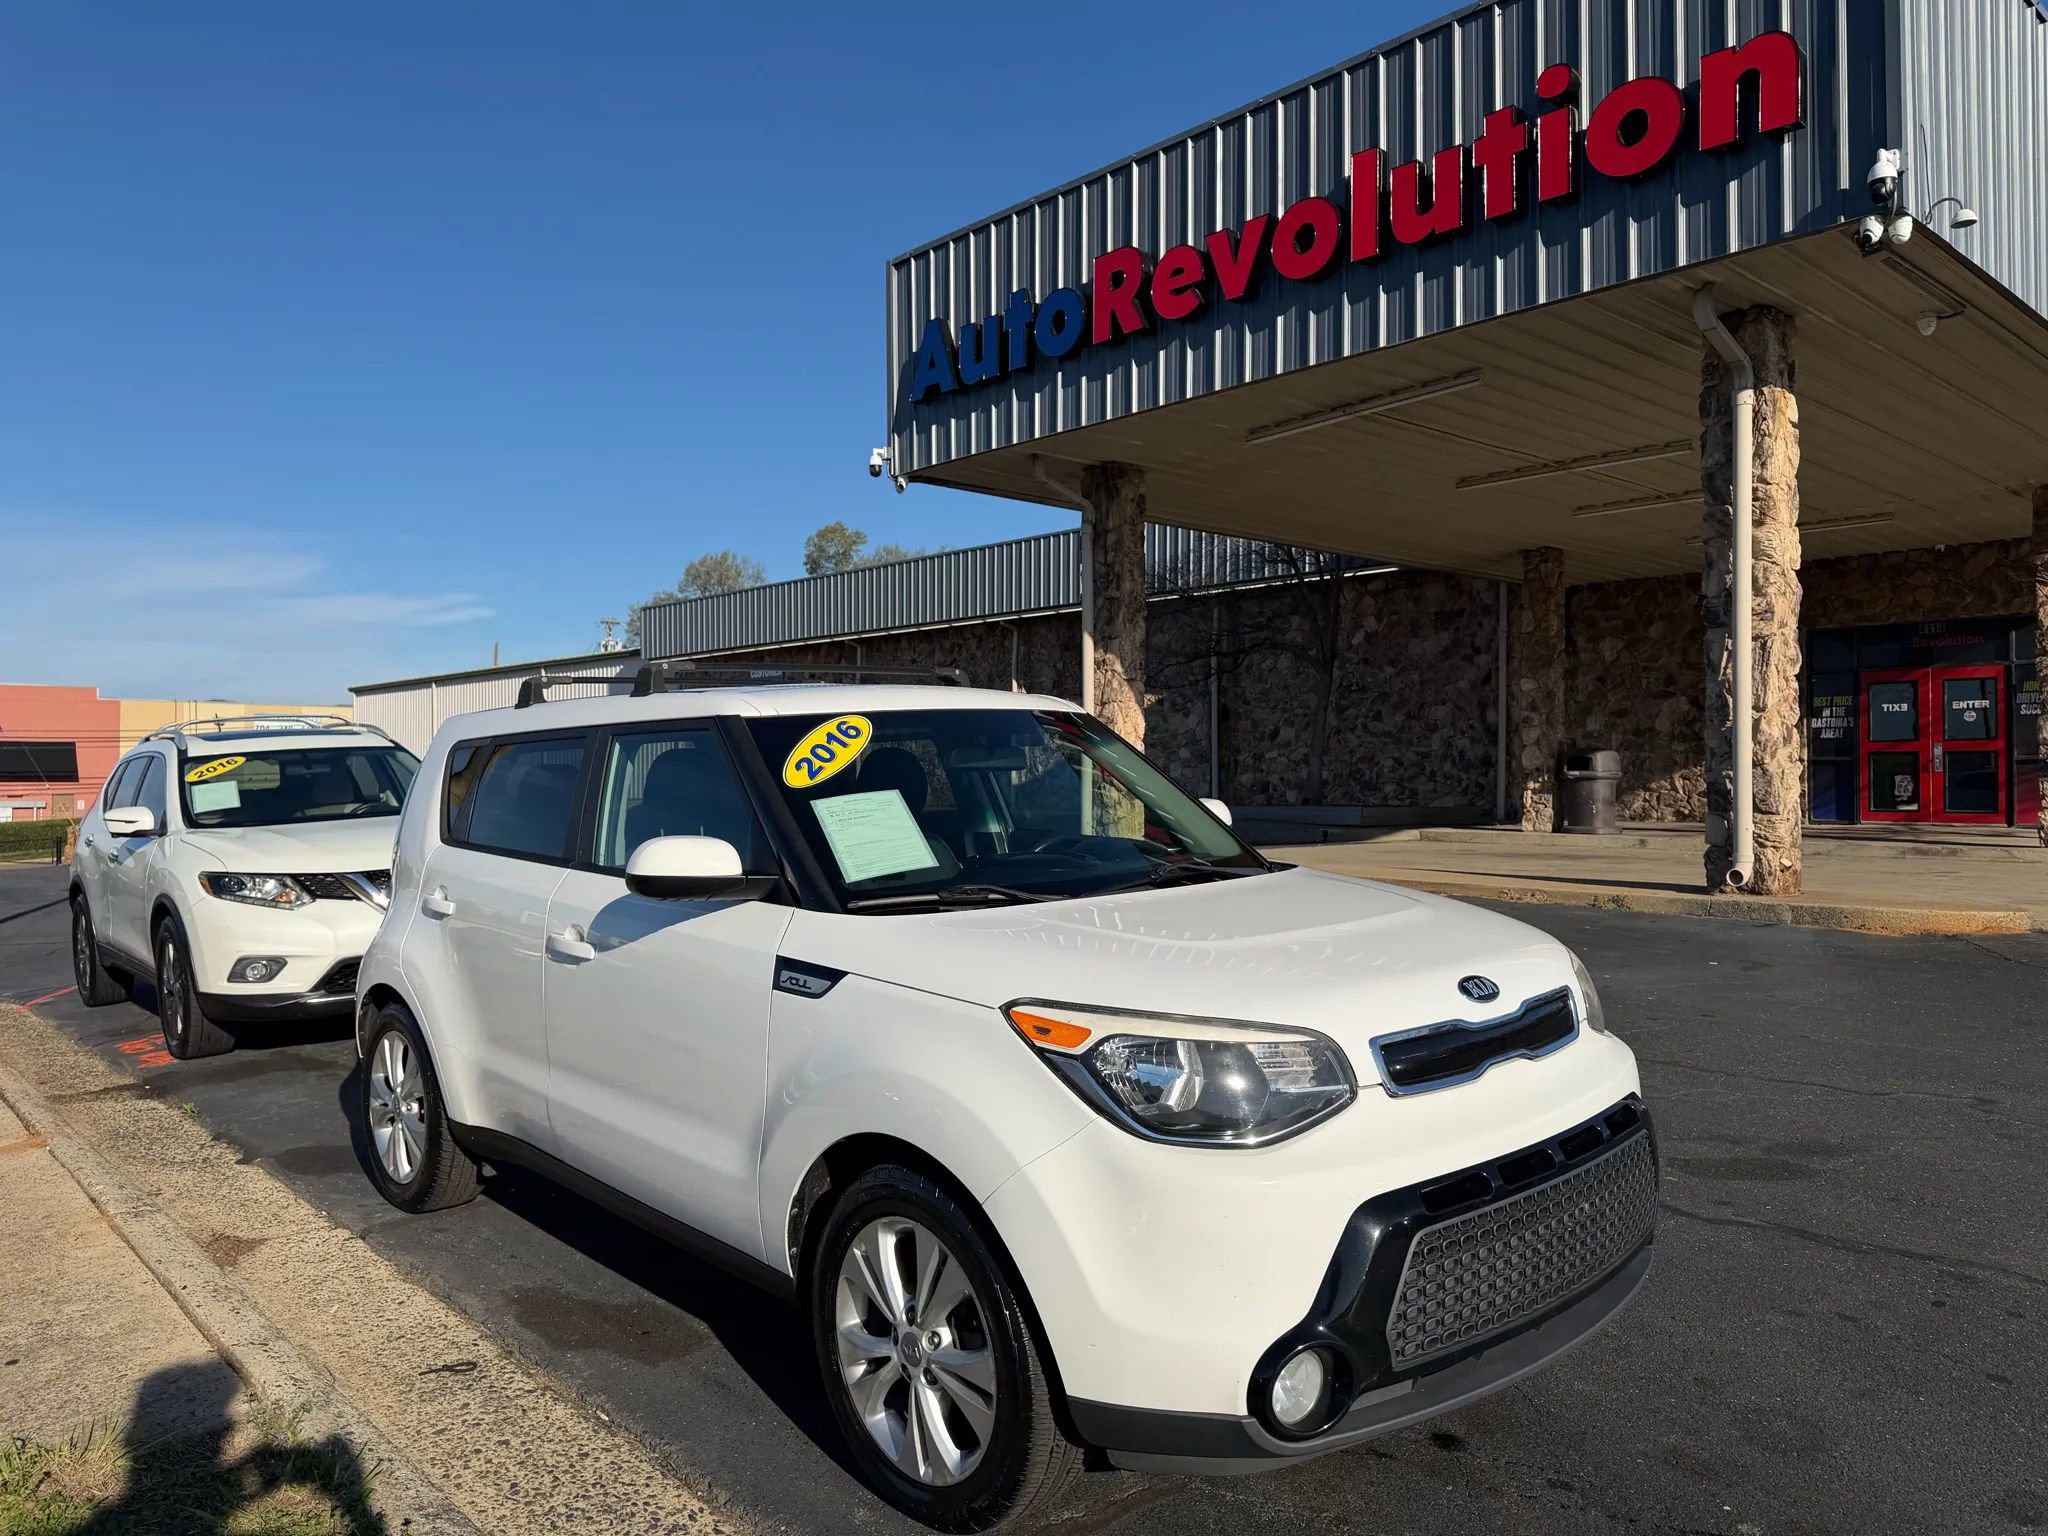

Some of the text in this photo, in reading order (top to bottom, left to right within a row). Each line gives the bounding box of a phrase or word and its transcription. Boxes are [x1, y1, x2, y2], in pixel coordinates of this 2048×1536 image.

[1813, 695, 1854, 707] BEST PRICE
[1952, 700, 1990, 710] ENTER
[1822, 706, 1847, 717] IN THE
[1820, 727, 1844, 739] AREA!
[795, 720, 863, 781] 2016
[194, 758, 238, 779] 2016
[1462, 978, 1498, 998] KIA
